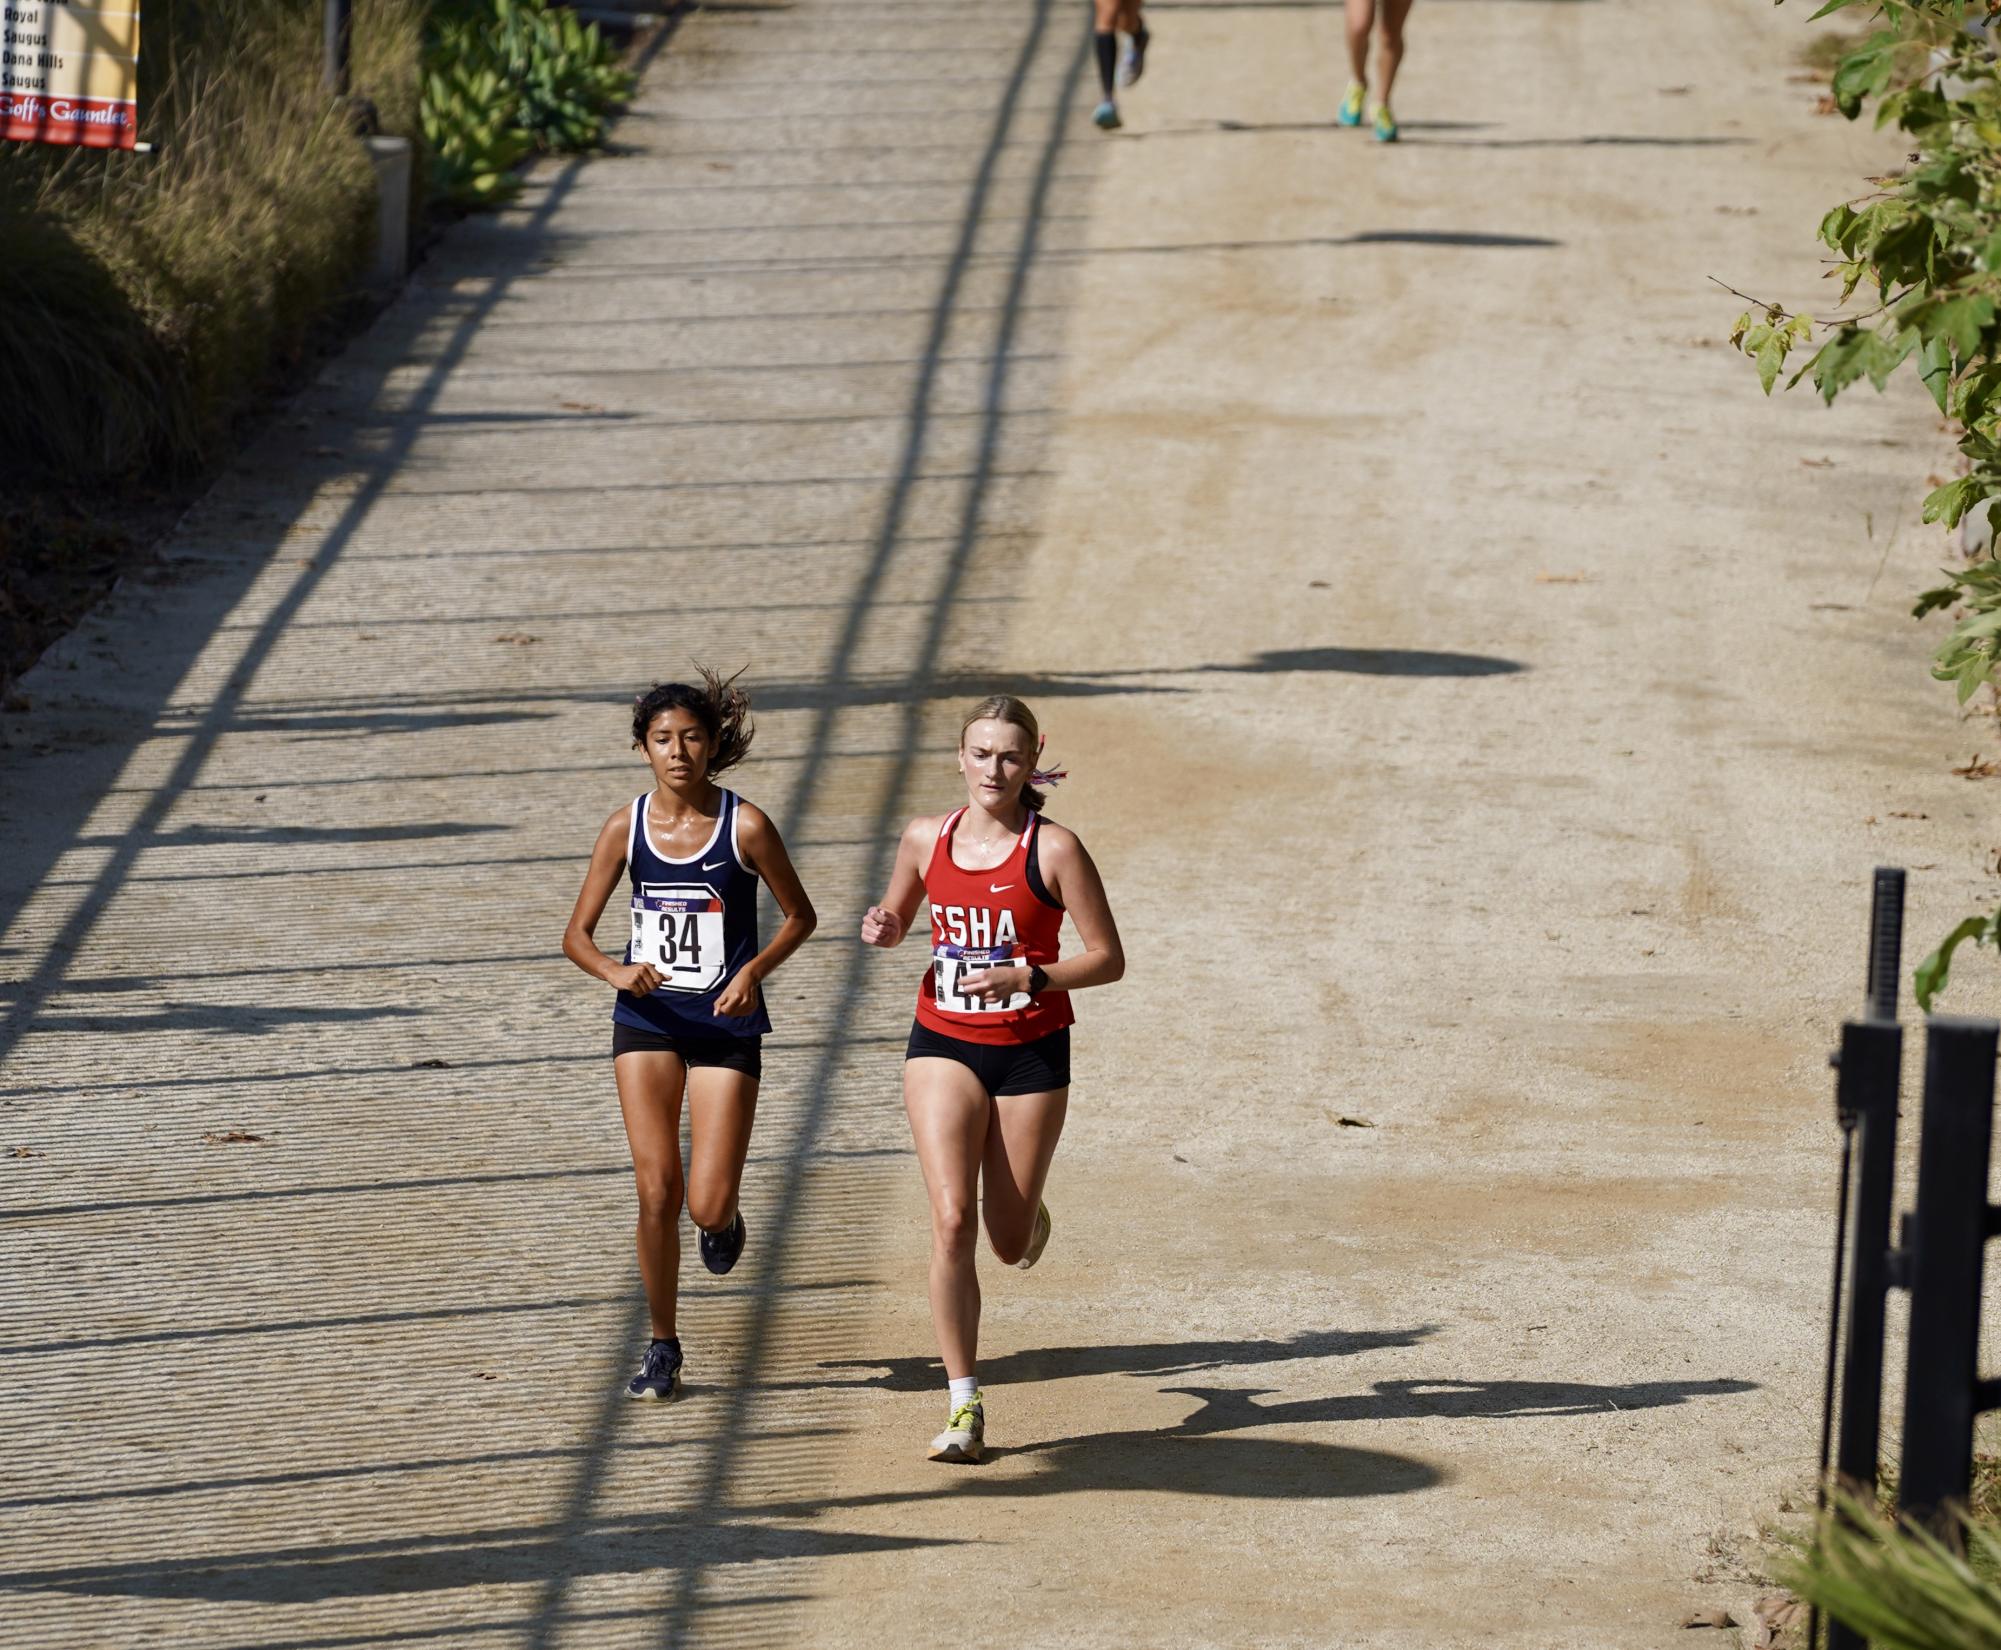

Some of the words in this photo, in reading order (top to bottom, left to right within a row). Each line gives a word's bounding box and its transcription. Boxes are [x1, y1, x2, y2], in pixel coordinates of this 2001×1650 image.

[4, 7, 38, 23] Royal
[4, 29, 47, 46] Saugus
[2, 51, 33, 66] Dana
[37, 54, 64, 69] Hills
[1, 72, 46, 89] Saugus
[658, 913, 702, 965] 34
